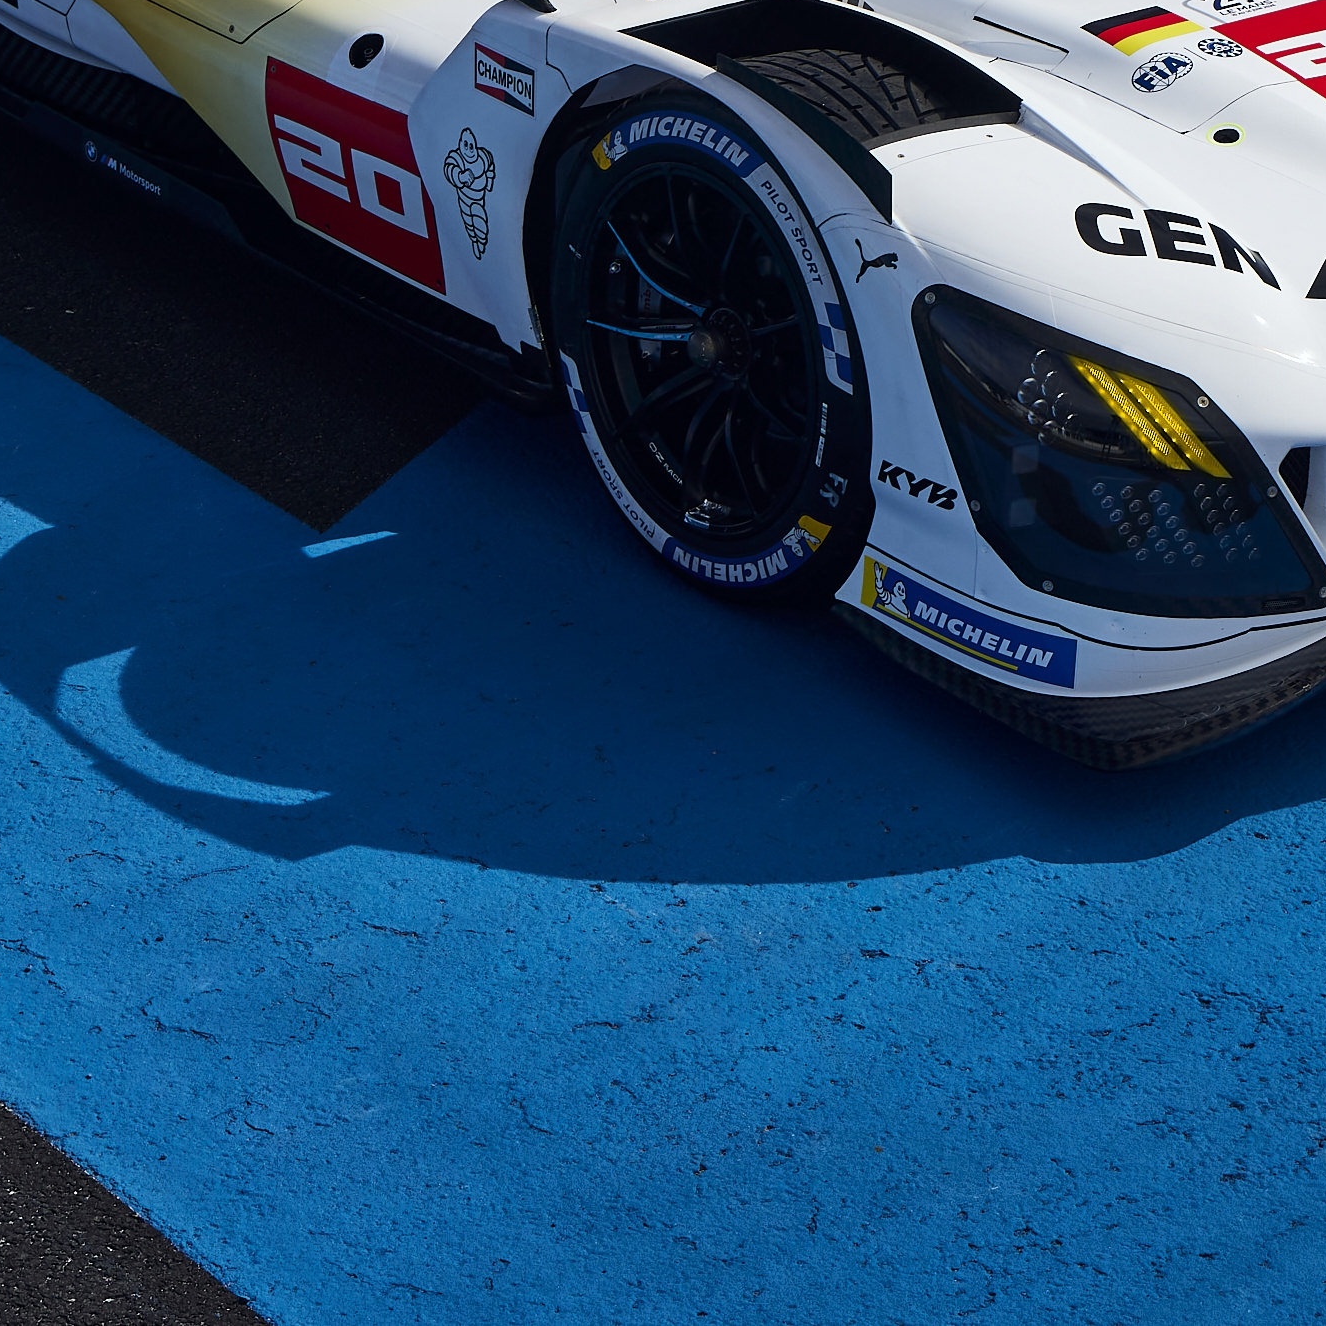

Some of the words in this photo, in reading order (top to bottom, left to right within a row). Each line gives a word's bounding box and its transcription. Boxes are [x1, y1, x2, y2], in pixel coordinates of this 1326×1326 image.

[477, 59, 533, 101] CHAMPION
[629, 116, 751, 168] MICHELIN
[119, 162, 162, 196] Motorsport
[273, 113, 429, 239] 20
[760, 179, 795, 224] PILOT
[790, 227, 824, 286] SPORT
[1075, 202, 1282, 291] GEN
[592, 450, 624, 500] SPORT
[819, 472, 849, 508] FR
[877, 459, 958, 511] KYB
[622, 503, 656, 539] PILOT
[672, 547, 789, 583] MICHELIN
[914, 600, 1054, 668] MICHELIN
